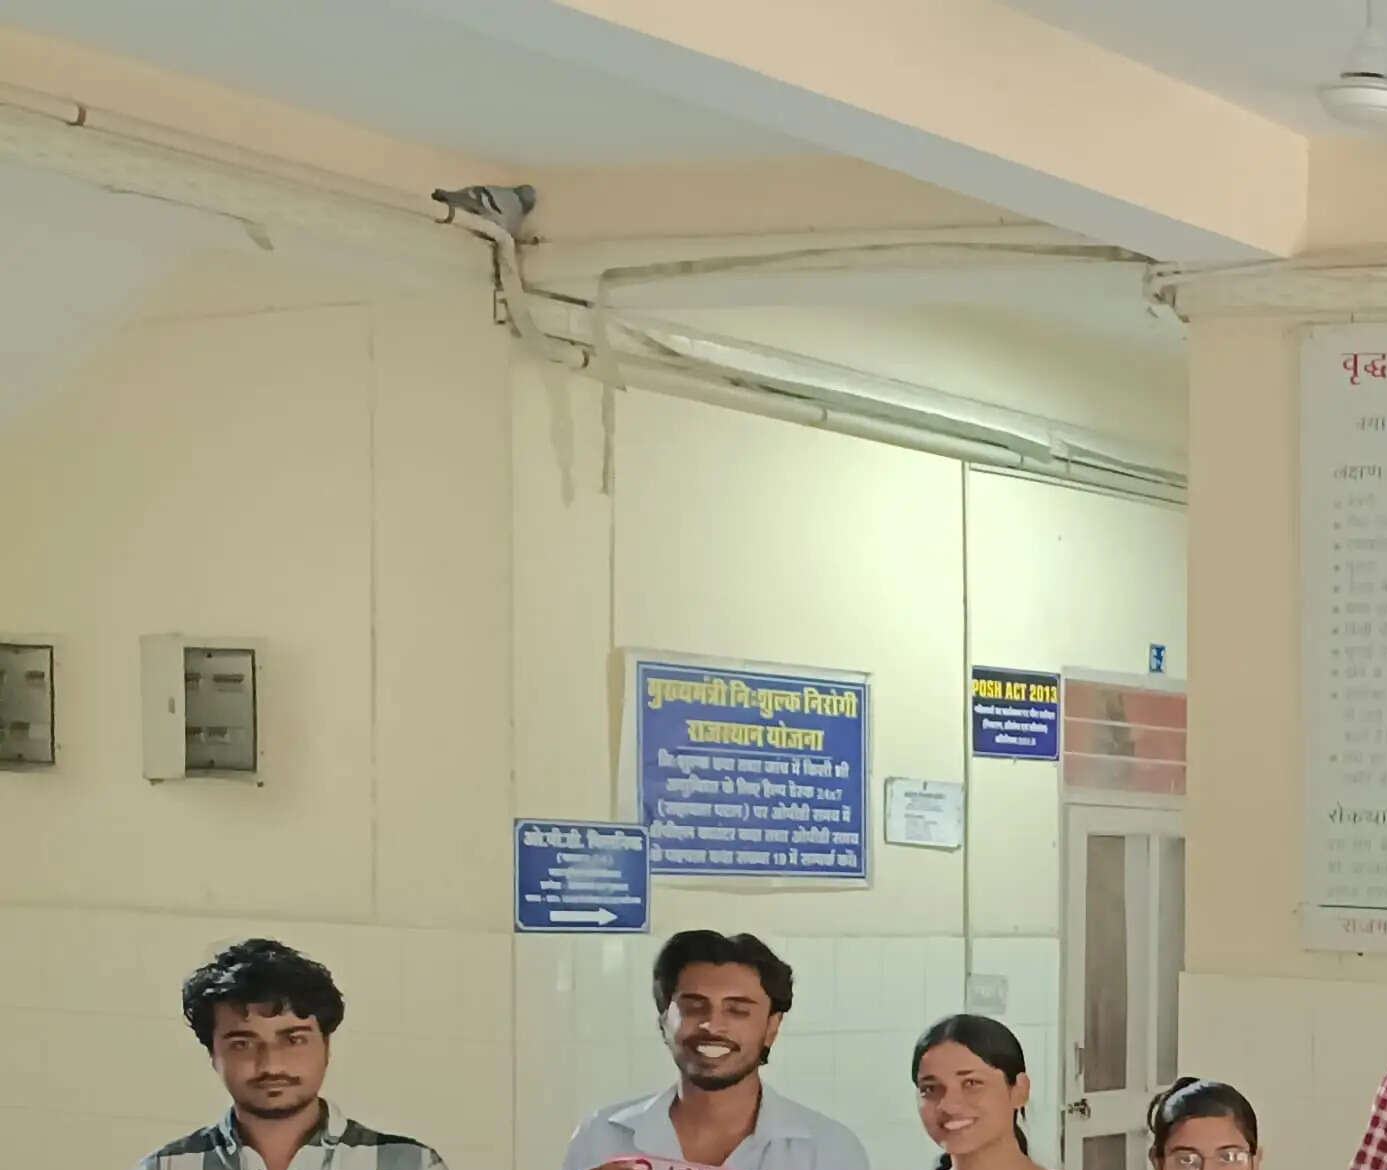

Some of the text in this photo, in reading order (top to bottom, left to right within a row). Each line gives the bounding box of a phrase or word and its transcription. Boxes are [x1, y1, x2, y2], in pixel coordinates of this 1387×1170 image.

[803, 686, 858, 718] निरोगी
[972, 679, 1058, 704] POSH ACT 2013
[686, 719, 825, 752] राजस्थान योजना
